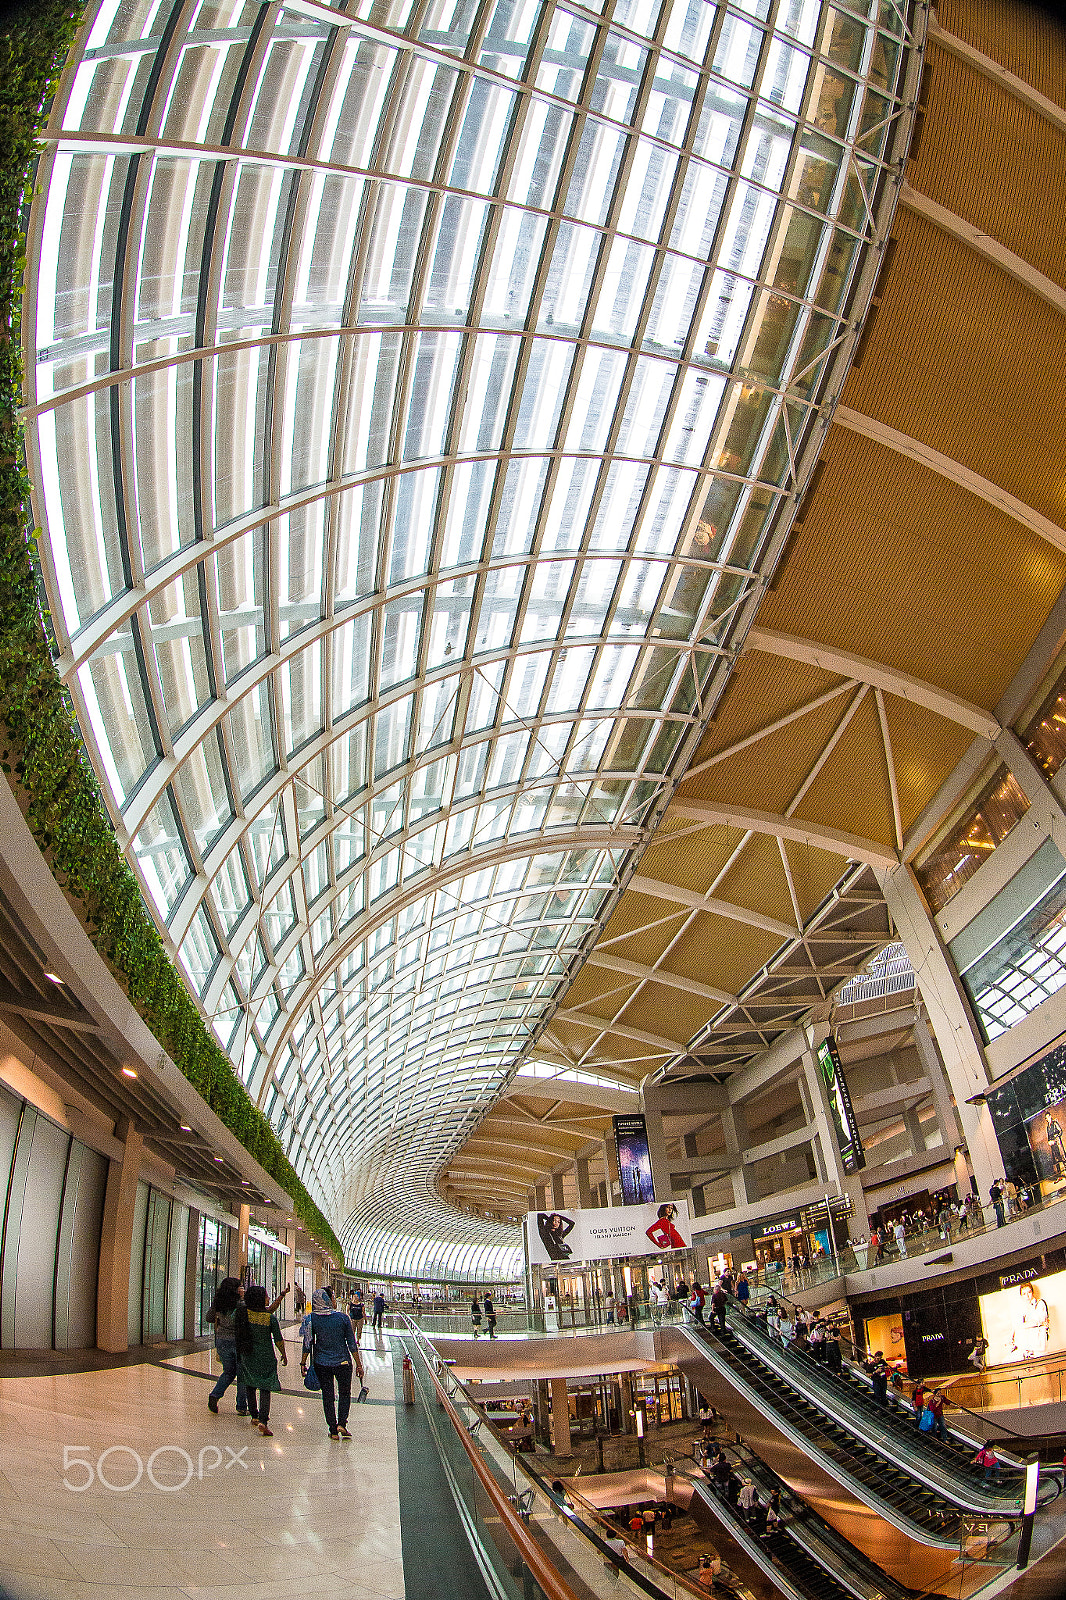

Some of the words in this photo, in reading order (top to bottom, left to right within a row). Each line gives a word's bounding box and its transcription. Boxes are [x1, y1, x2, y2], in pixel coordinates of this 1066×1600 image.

[609, 1225, 636, 1233] VUITTON
[762, 1220, 796, 1235] LOEWE
[1000, 1268, 1039, 1286] PRADA
[921, 1332, 945, 1342] PRADA
